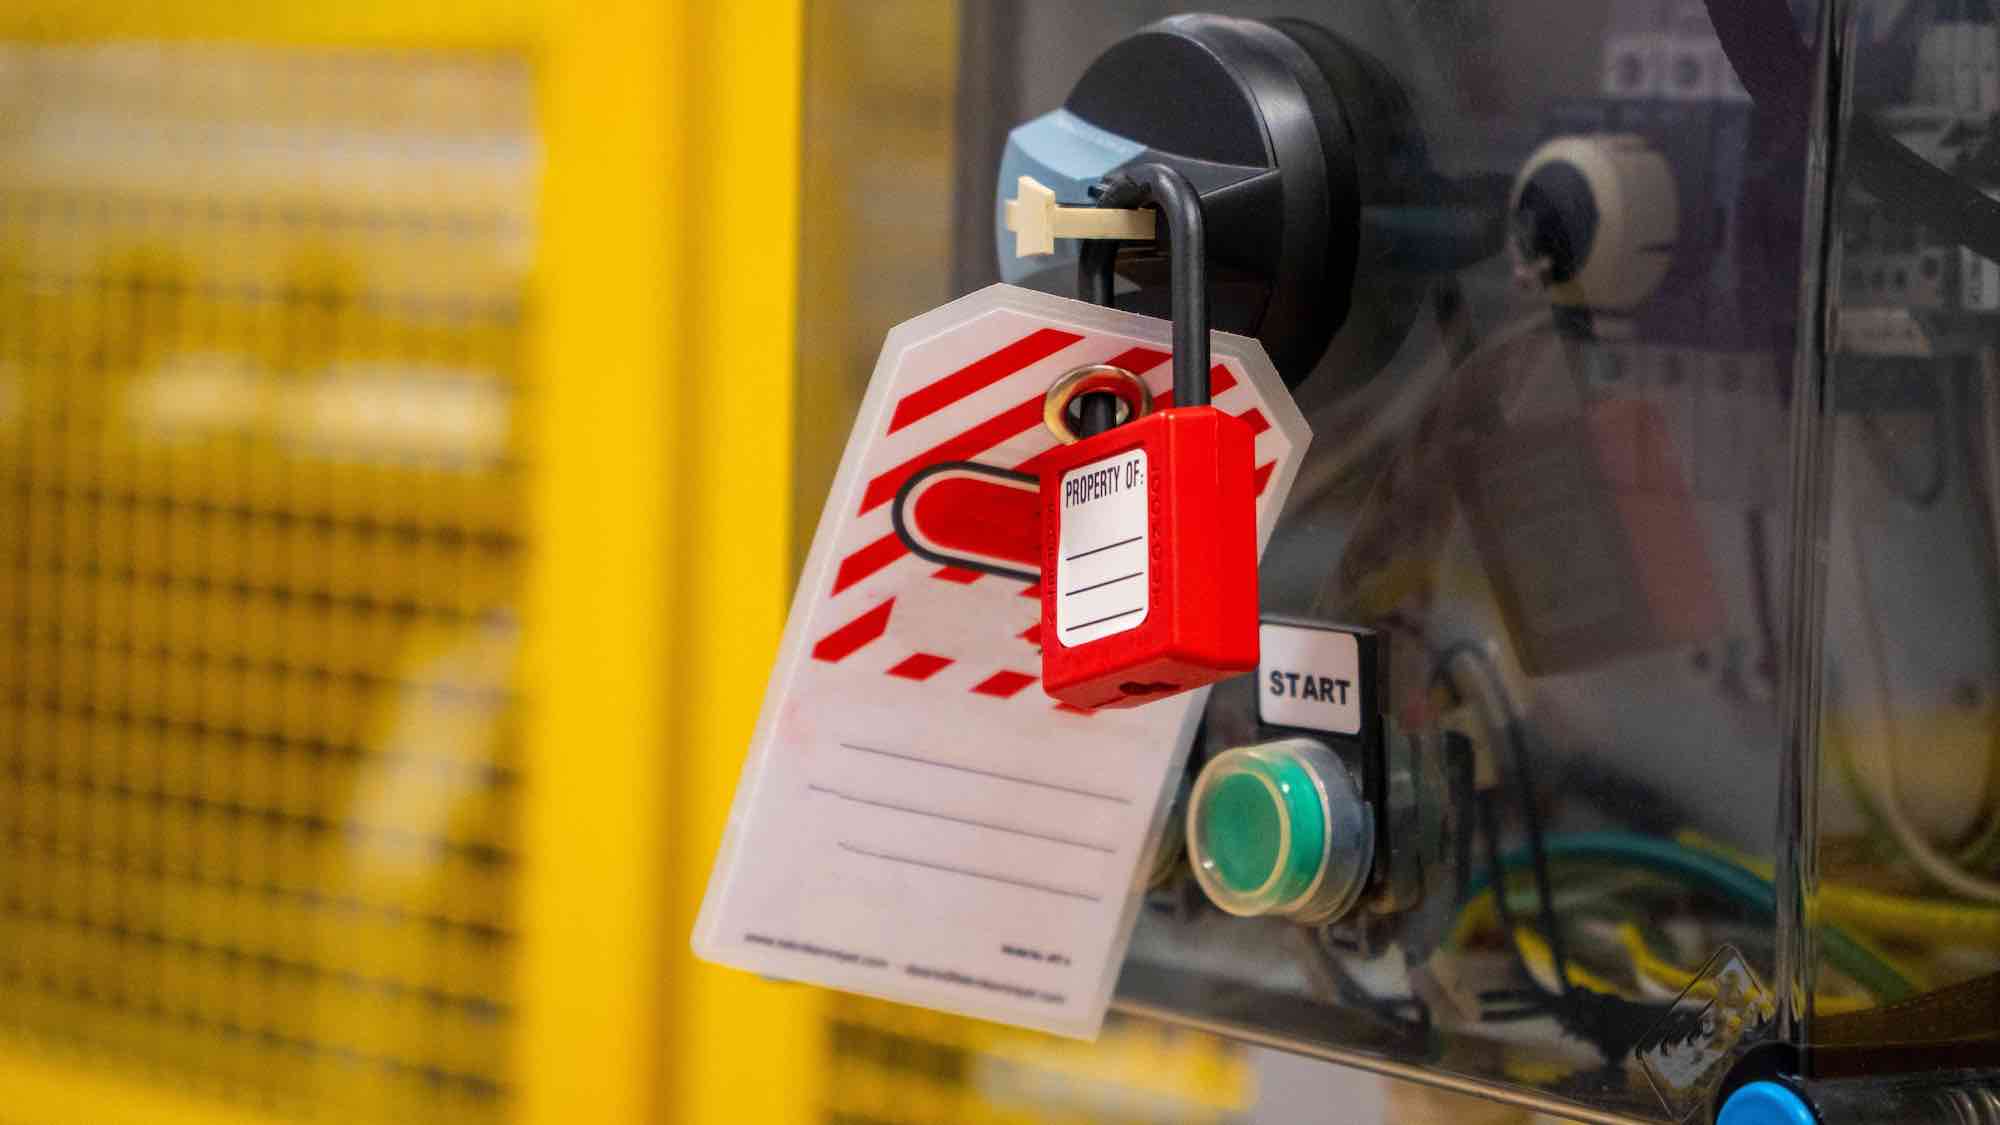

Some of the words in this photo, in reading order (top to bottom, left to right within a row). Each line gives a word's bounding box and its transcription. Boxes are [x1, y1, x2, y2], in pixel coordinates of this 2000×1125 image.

[1066, 465, 1120, 508] PROPERTY
[1126, 459, 1144, 489] OF:
[1270, 669, 1351, 705] START
